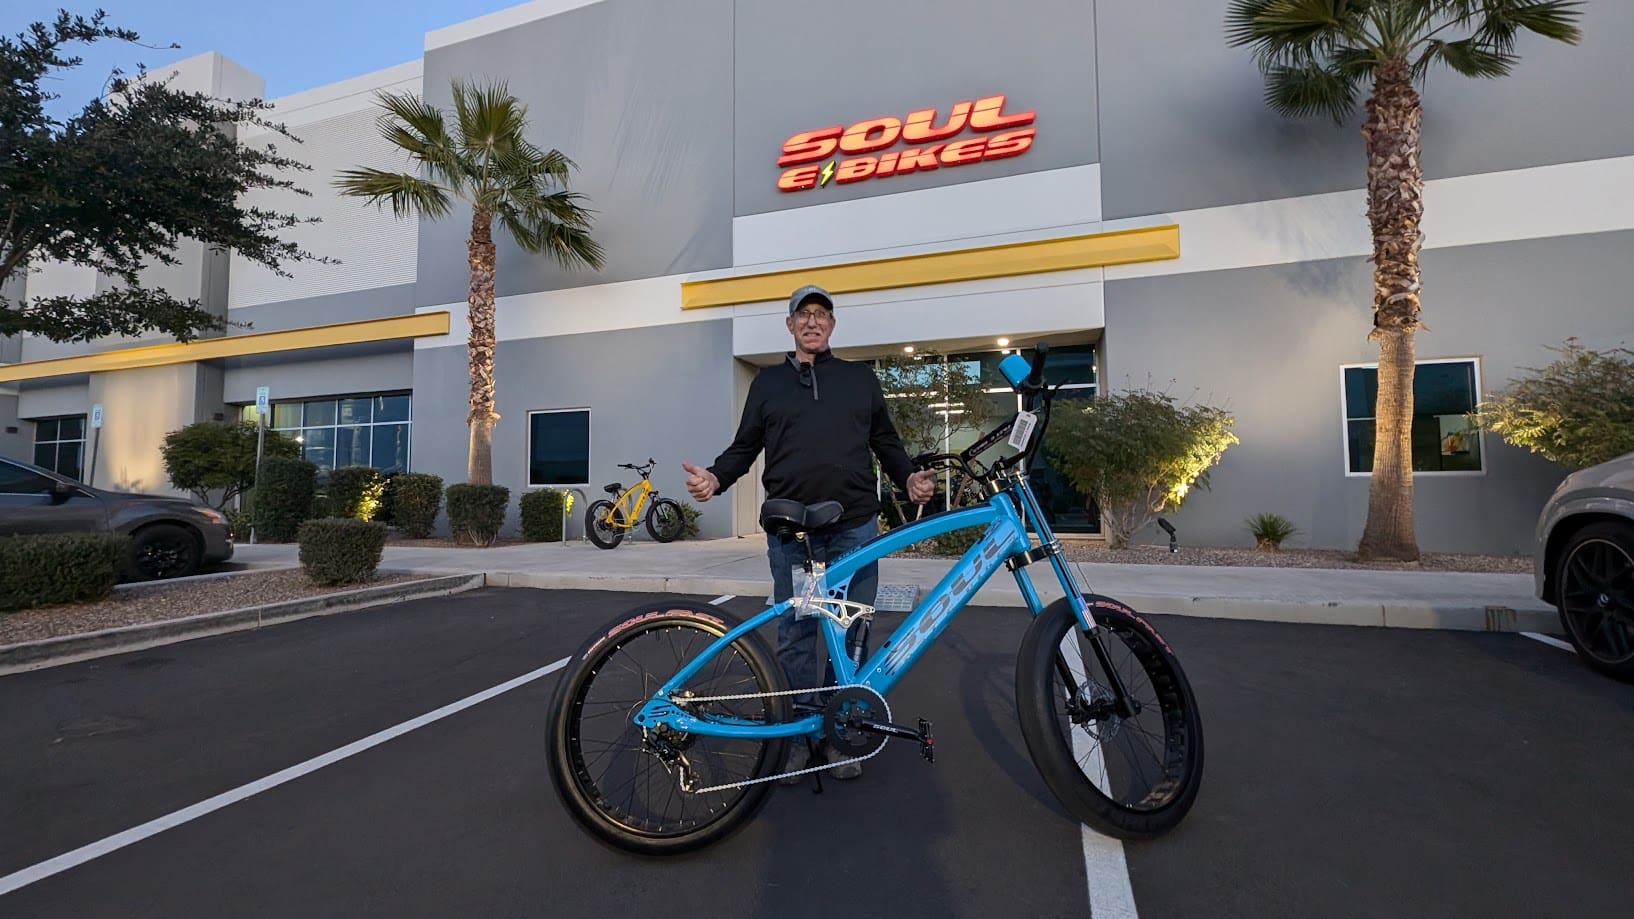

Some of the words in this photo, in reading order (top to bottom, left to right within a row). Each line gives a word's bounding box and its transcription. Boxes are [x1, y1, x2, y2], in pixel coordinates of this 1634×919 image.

[778, 95, 1036, 168] SOUL
[835, 127, 1036, 184] BIKES
[885, 529, 1016, 675] SOUL
